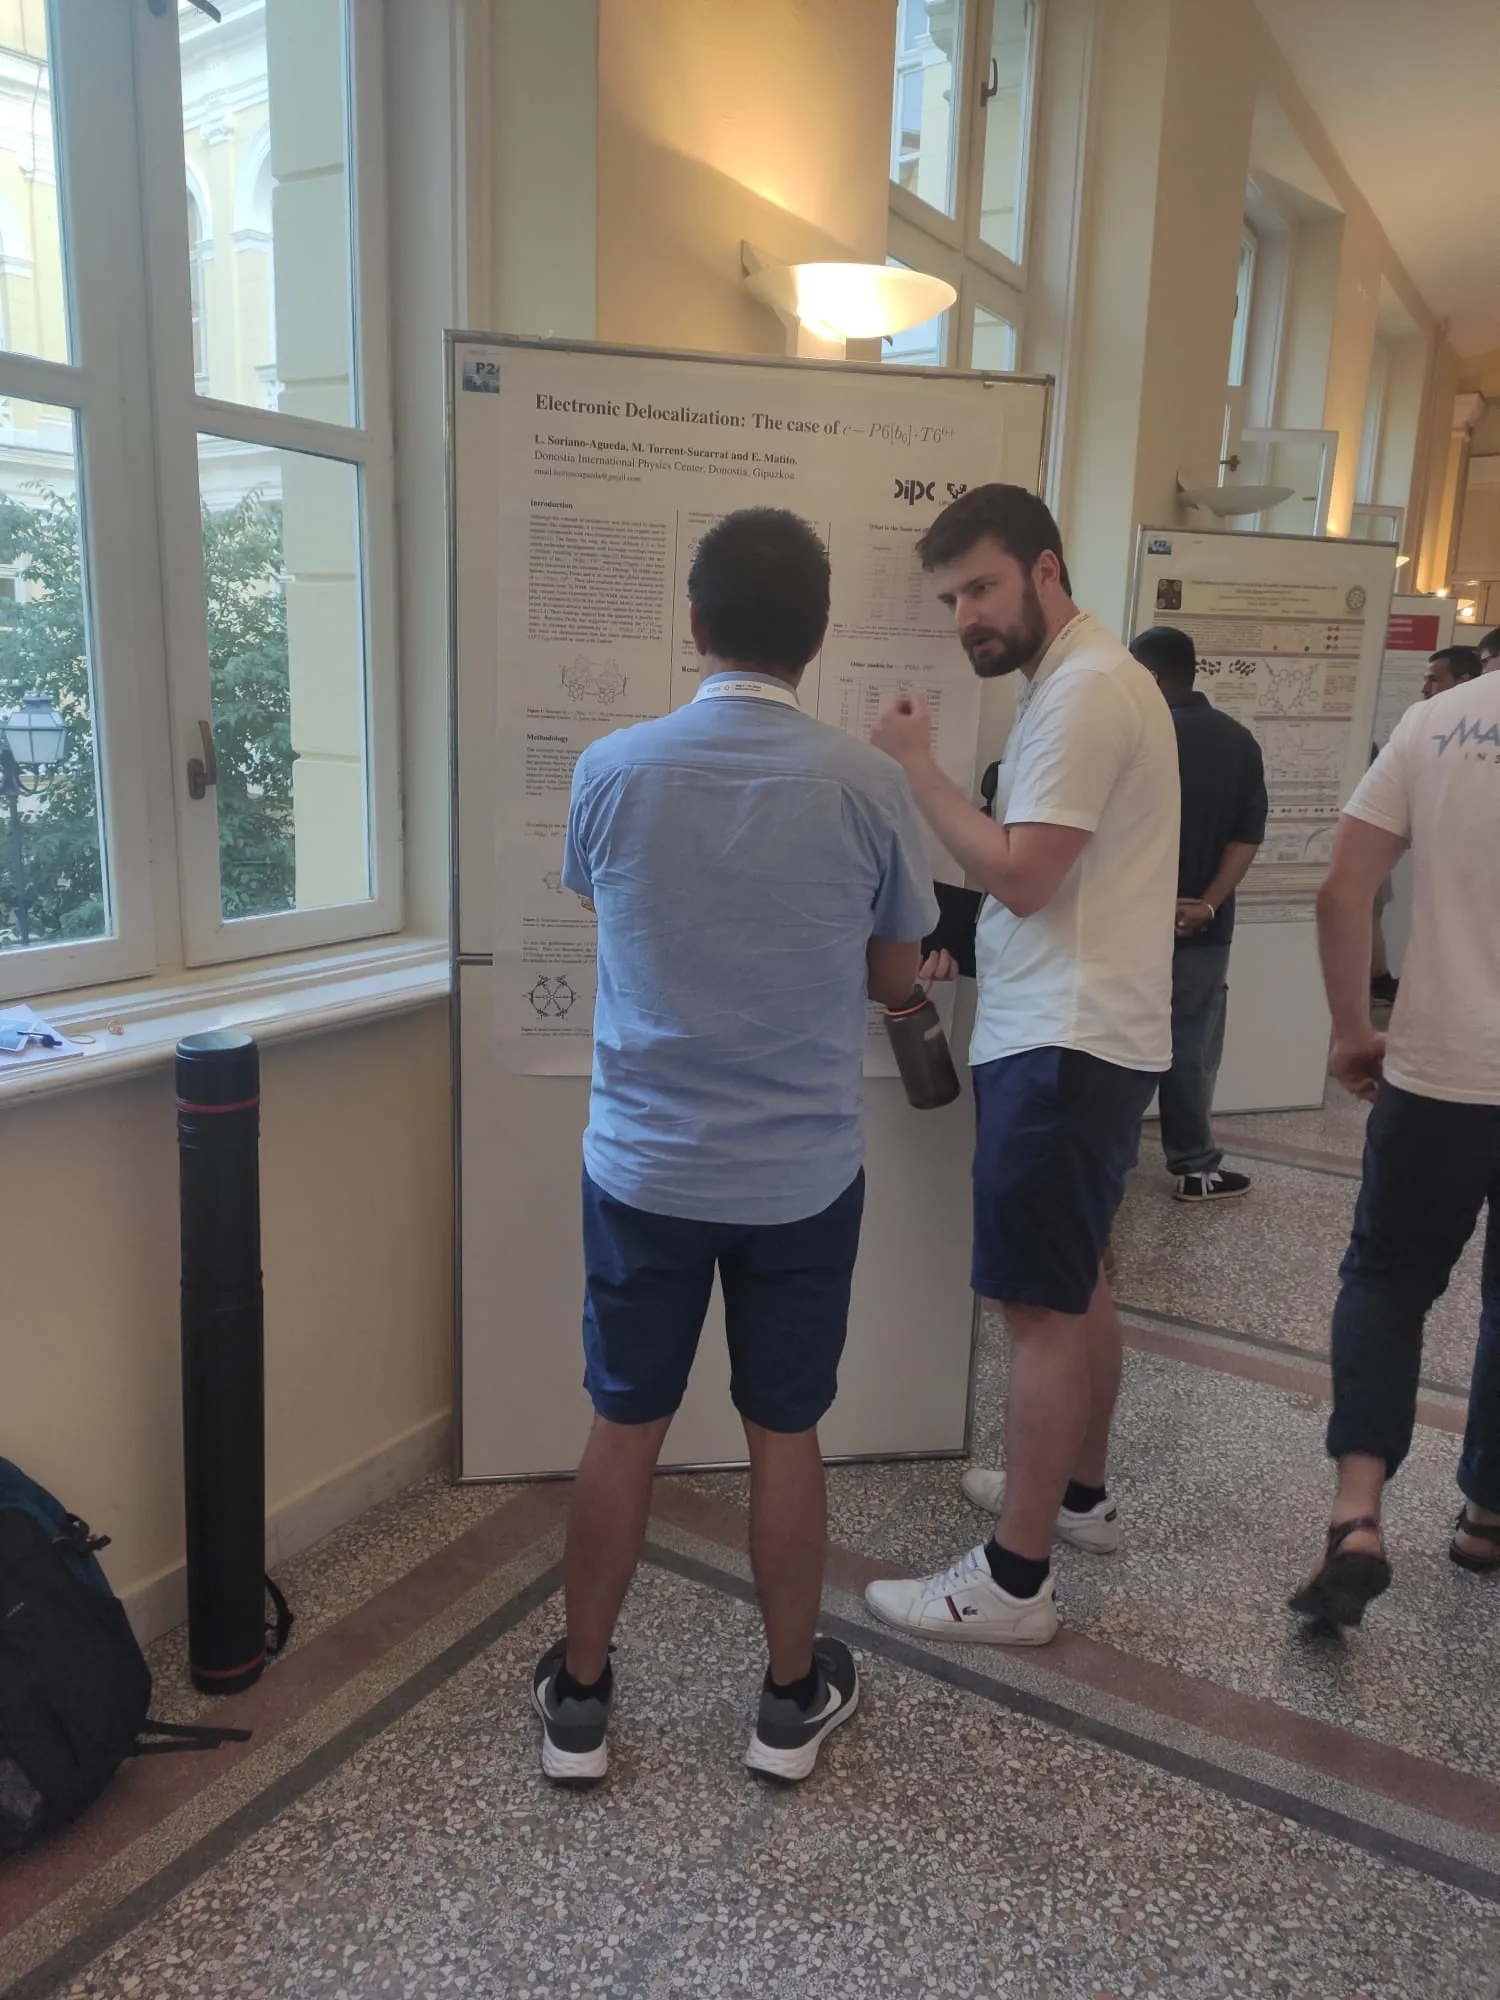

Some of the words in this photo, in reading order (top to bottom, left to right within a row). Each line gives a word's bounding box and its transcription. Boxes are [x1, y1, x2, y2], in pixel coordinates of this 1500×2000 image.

[536, 393, 620, 416] Electronic
[625, 402, 745, 427] Delocalization:
[752, 413, 783, 430] The
[787, 419, 819, 434] case
[824, 420, 841, 435] of
[535, 434, 545, 444] L.
[631, 442, 645, 452] M.
[731, 452, 748, 461] and
[534, 450, 575, 463] Donostia
[579, 454, 635, 468] International
[638, 459, 671, 472] Physics
[674, 462, 706, 474] Center,
[530, 499, 573, 510] Introduction
[526, 733, 568, 744] Methodology
